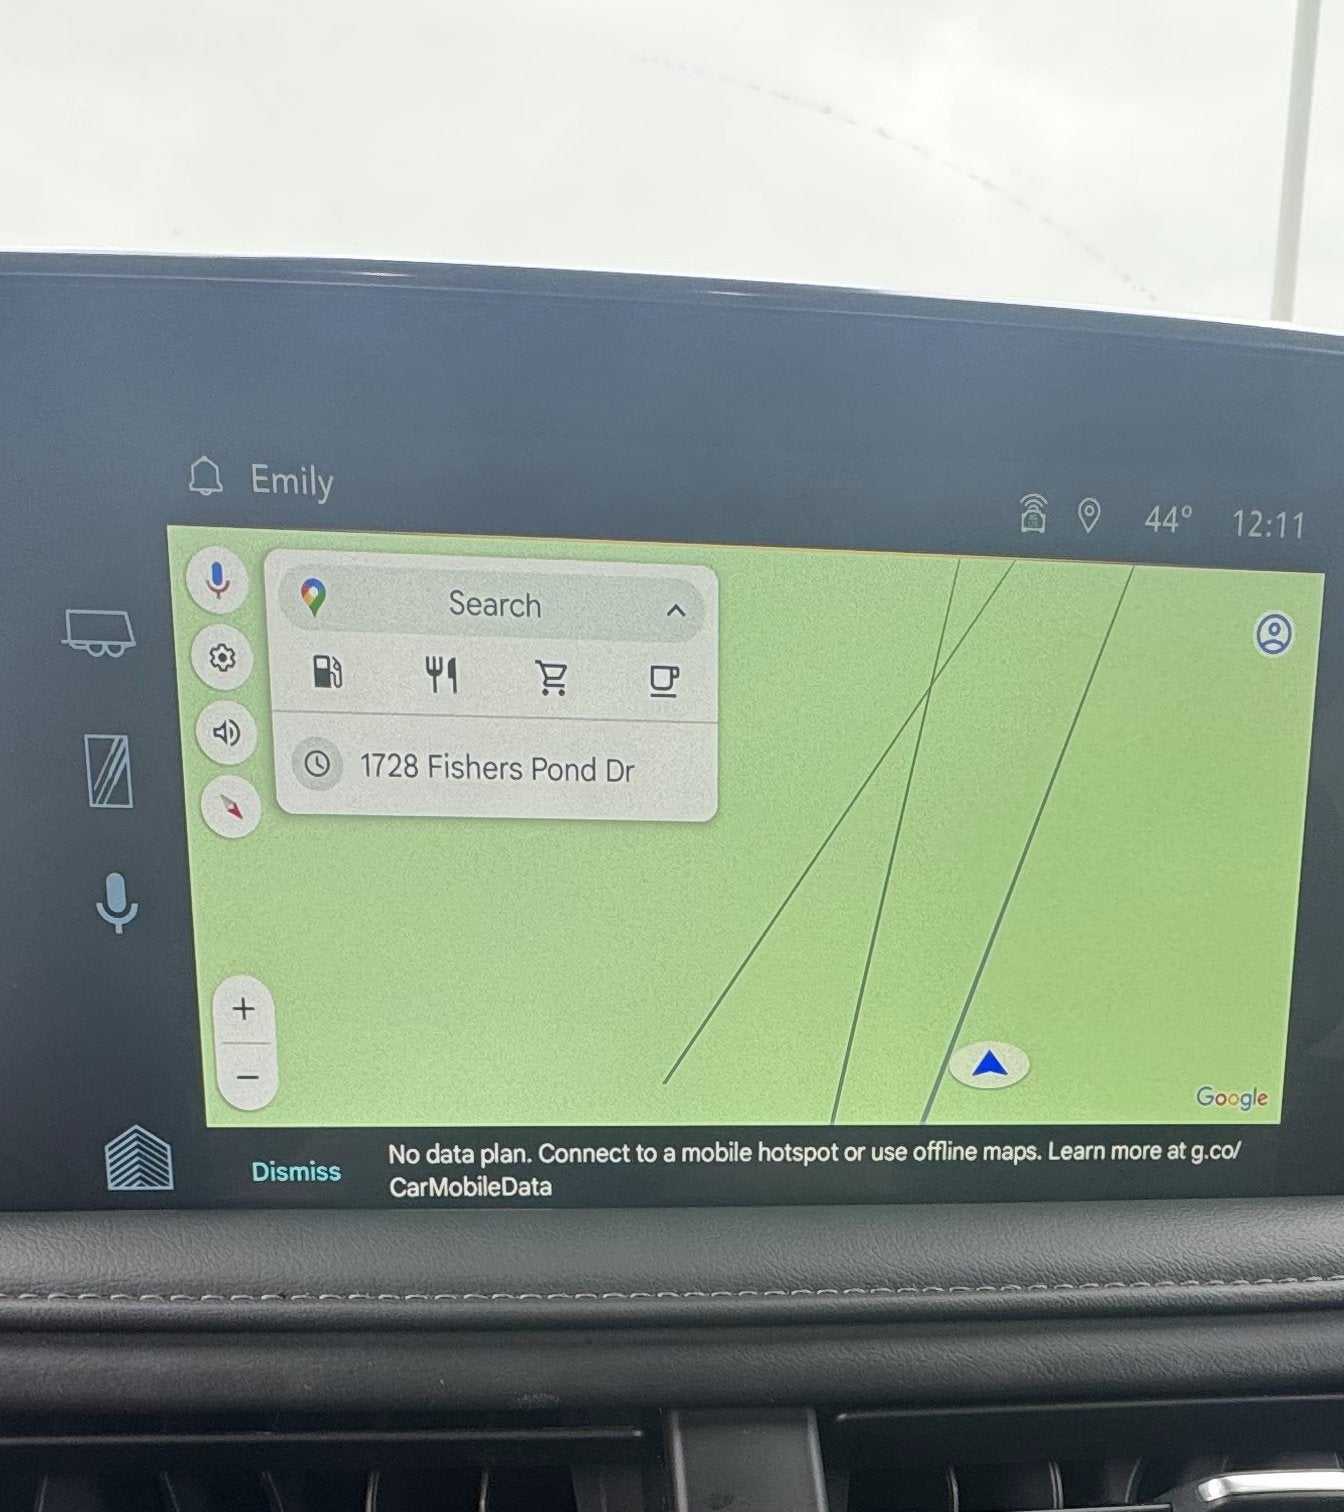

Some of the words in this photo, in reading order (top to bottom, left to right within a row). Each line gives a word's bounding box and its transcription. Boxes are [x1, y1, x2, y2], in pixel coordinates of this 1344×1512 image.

[251, 463, 335, 504] Emily
[1233, 510, 1305, 540] 12:11
[448, 589, 543, 620] Search
[360, 752, 420, 780] 1728
[428, 753, 524, 781] Fishers
[531, 755, 598, 784] Pond
[606, 758, 636, 784] Dr
[1195, 1085, 1269, 1112] Google
[387, 1143, 419, 1166] No
[425, 1142, 475, 1165] data
[480, 1142, 533, 1169] plan.
[538, 1141, 630, 1165] Connect
[635, 1142, 658, 1163] to
[663, 1146, 676, 1163] a
[681, 1140, 753, 1163] mobile
[758, 1141, 839, 1167] hotspot
[844, 1144, 866, 1162] or
[871, 1144, 908, 1162] use
[912, 1140, 978, 1162] offline
[983, 1144, 1042, 1168] maps.
[1048, 1140, 1106, 1161] Learn
[1111, 1143, 1162, 1161] more
[1167, 1143, 1186, 1161] at
[1191, 1140, 1242, 1166] g.co/
[252, 1160, 342, 1183] Dismiss
[389, 1176, 553, 1198] CarMobileData
